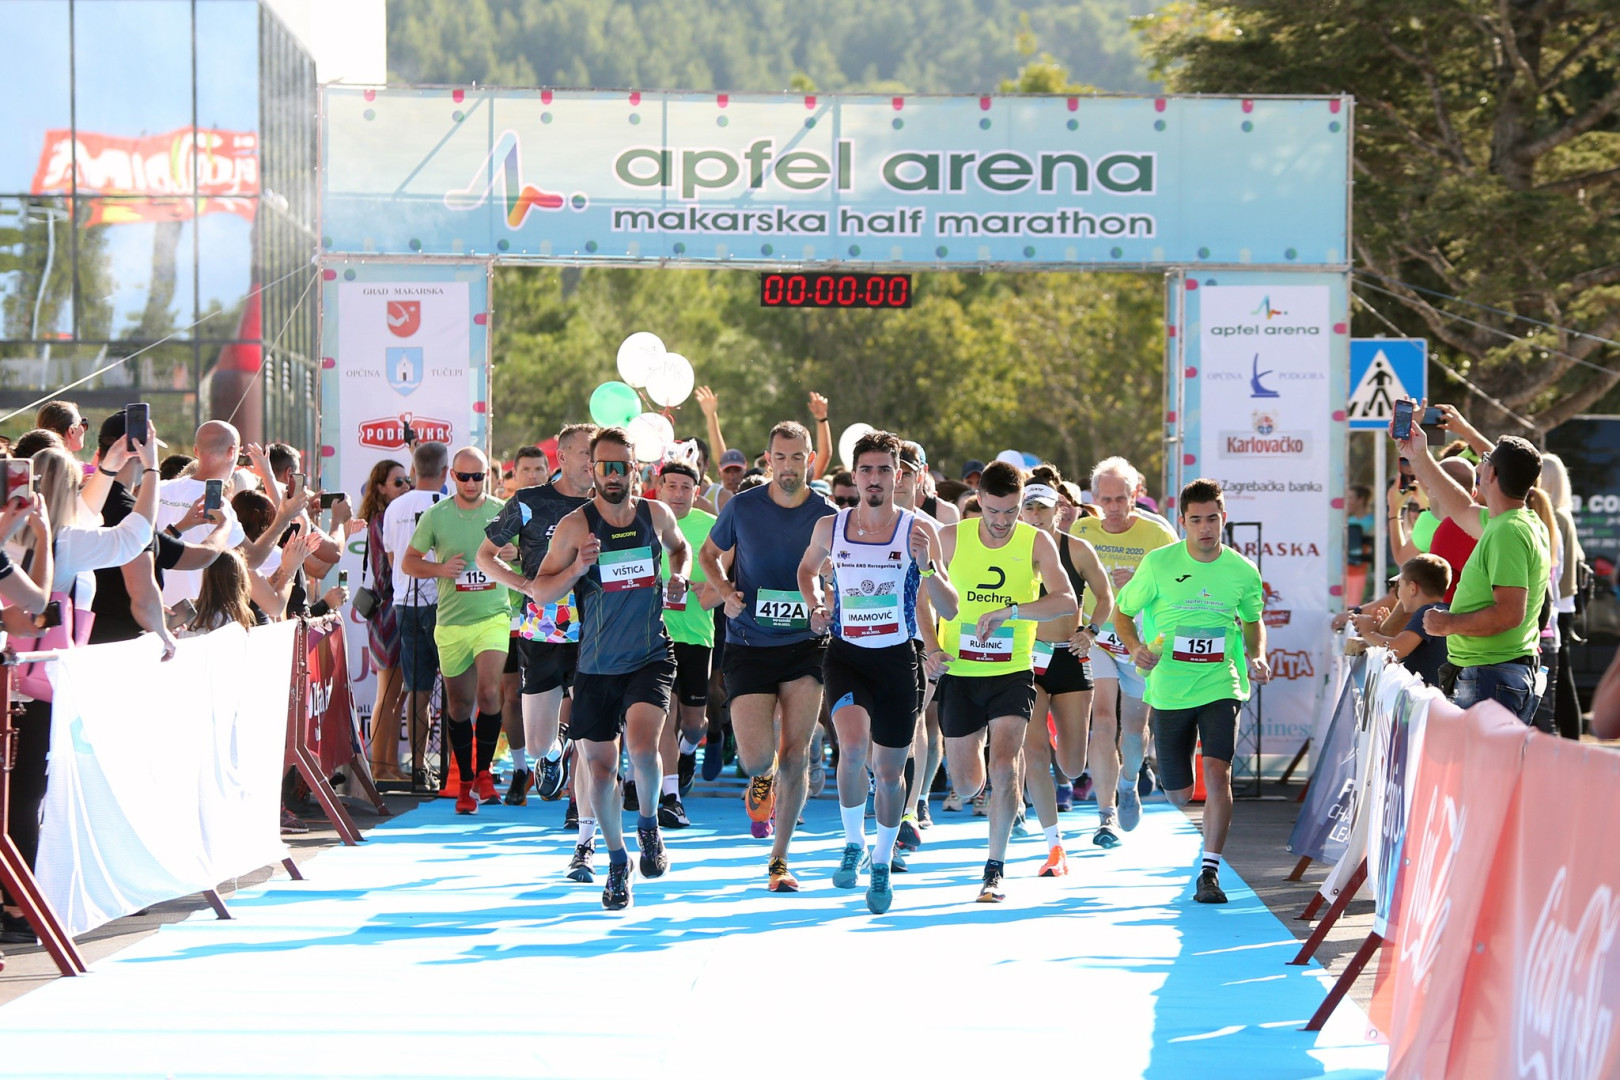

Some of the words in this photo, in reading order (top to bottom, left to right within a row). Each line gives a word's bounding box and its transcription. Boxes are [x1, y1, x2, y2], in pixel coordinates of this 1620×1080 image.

[614, 139, 852, 199] apfel
[882, 152, 1154, 193] arena
[613, 207, 827, 233] makarska
[840, 208, 923, 234] half
[938, 210, 1153, 235] marathon
[363, 287, 389, 295] GRAD
[394, 287, 444, 295] MAKARSKA
[1210, 325, 1259, 337] apfel
[1264, 326, 1320, 335] arena
[432, 367, 463, 377] TUČEPI
[1279, 371, 1325, 381] PODGORA
[366, 427, 445, 441] PODRVKA
[1226, 435, 1304, 454] Karlovačko
[1221, 480, 1285, 494] Zagrebačka
[1288, 481, 1322, 492] banka
[1095, 544, 1124, 553] MOSTAR
[1126, 547, 1144, 555] 2020
[612, 565, 645, 576] VIŠTICA
[466, 571, 486, 583] 115
[967, 591, 1012, 604] Dechra
[760, 601, 804, 618] 412A
[848, 609, 893, 621] IMAMOVIĆ
[969, 640, 1003, 651] RUBINIĆ
[1188, 639, 1213, 653] 151
